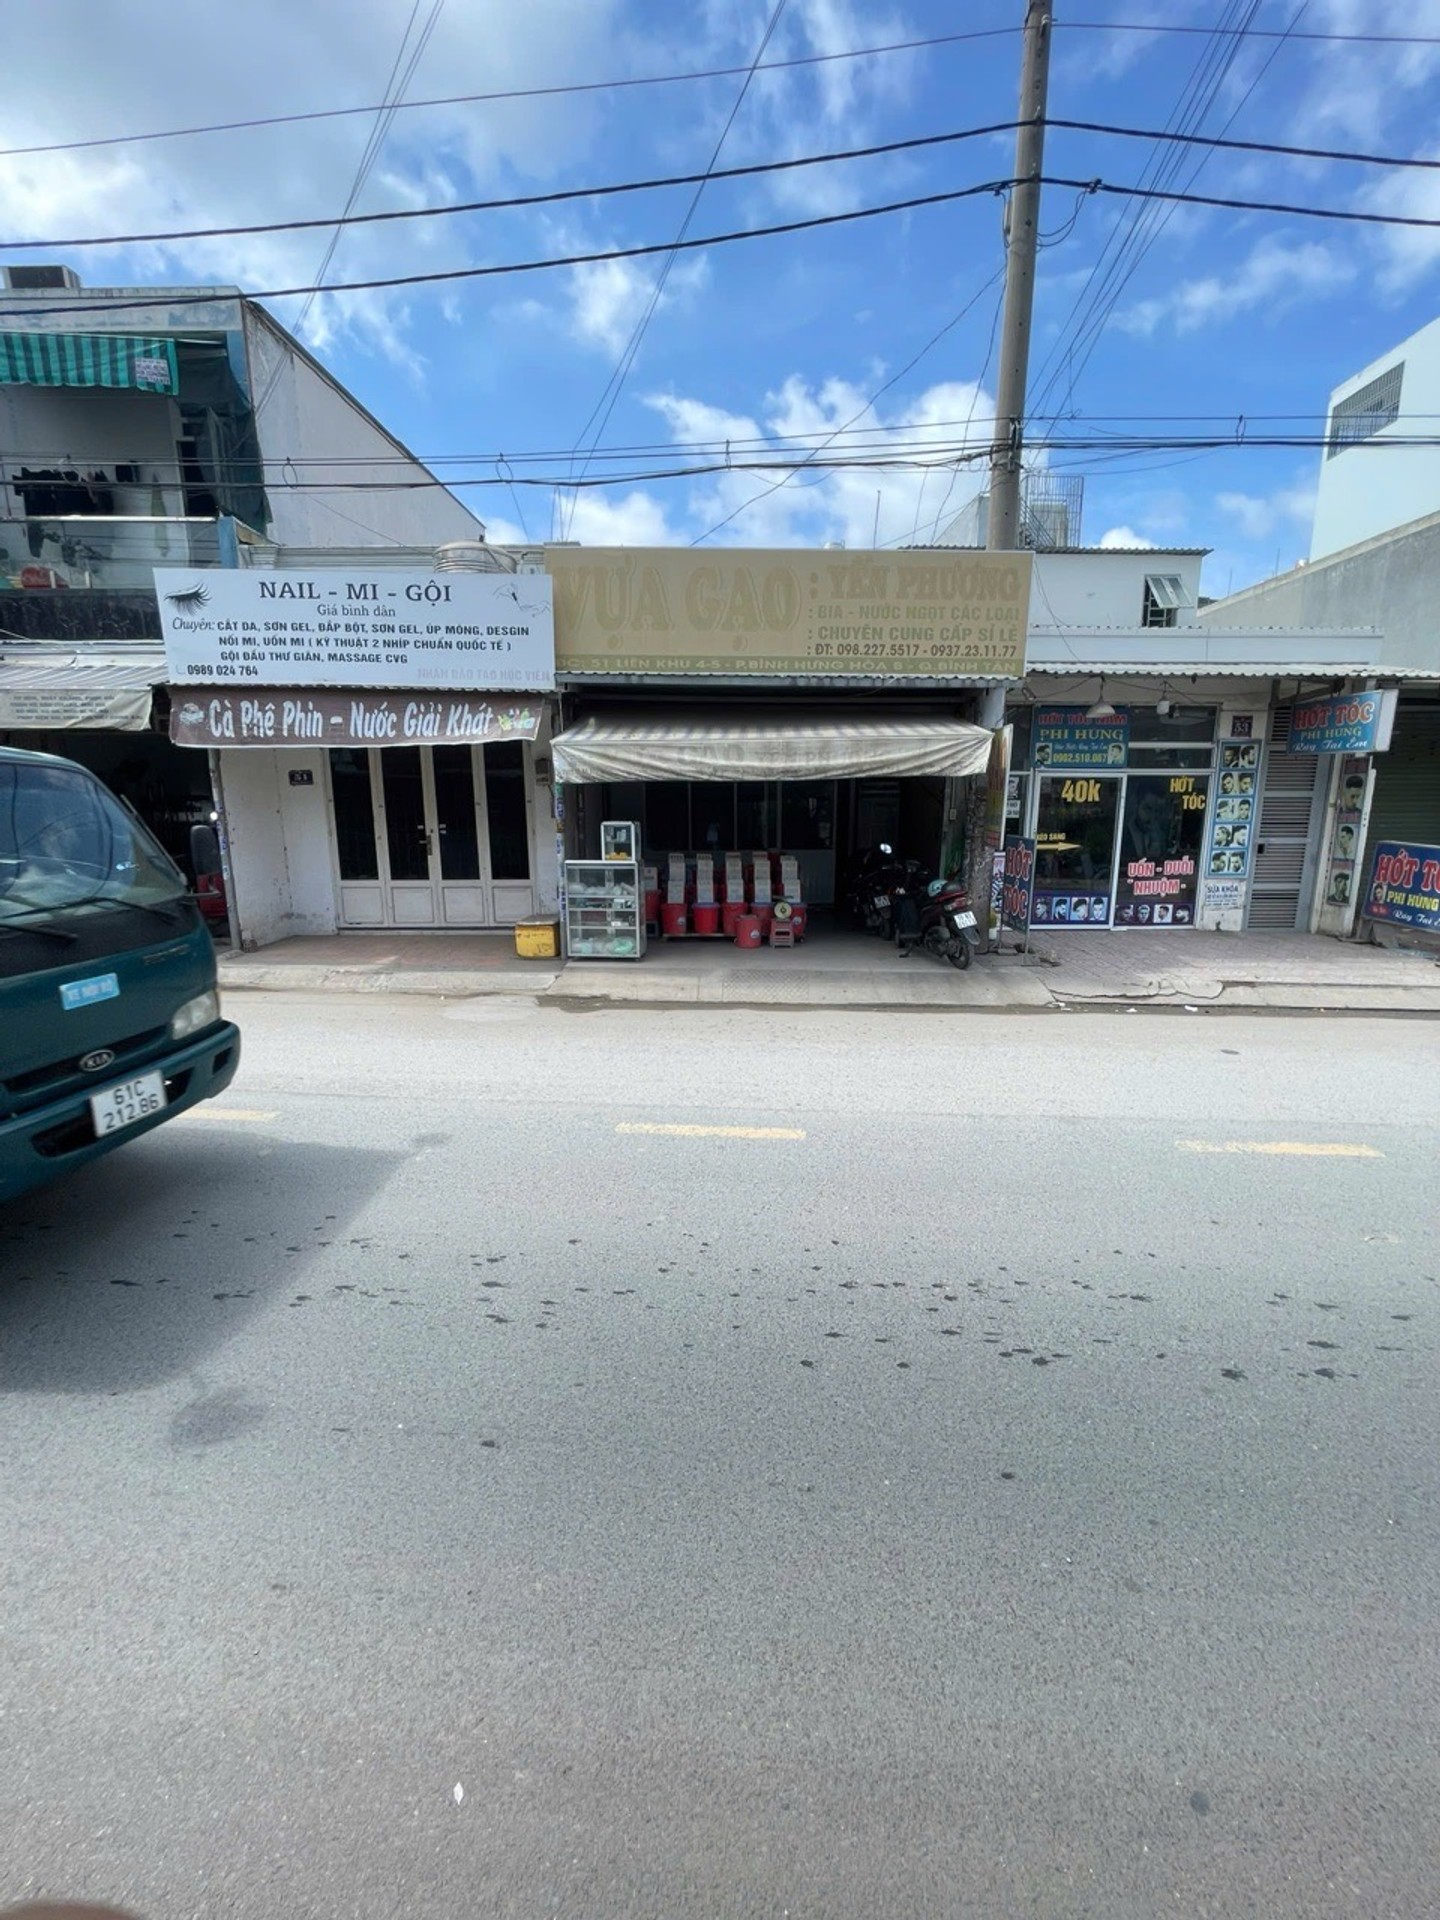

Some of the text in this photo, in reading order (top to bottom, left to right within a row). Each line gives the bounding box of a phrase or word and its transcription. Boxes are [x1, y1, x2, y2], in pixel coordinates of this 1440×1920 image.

[259, 582, 320, 600] NAIL
[346, 583, 379, 600] MI
[405, 579, 452, 606] GỘI
[317, 604, 396, 617] Giá bình dân
[817, 607, 843, 619] BIA
[950, 604, 981, 619] CÁC
[172, 617, 214, 633] Chuyên:
[217, 620, 238, 631] CẮT
[264, 620, 287, 632] SƠN
[372, 624, 395, 634] SƠN
[487, 626, 530, 636] DESGIN
[817, 624, 883, 640] CHUYÊN
[889, 627, 934, 641] CUNG
[939, 622, 973, 641] CẤP
[218, 635, 239, 646] NỐI
[263, 635, 288, 646] UỐN
[291, 637, 305, 646] MI
[333, 637, 369, 649] THUẬT
[372, 640, 379, 648] 2
[456, 638, 487, 651] QUỐC
[490, 639, 504, 651] TẾ
[814, 644, 834, 656] ĐT:
[836, 643, 920, 657] 098.227.5517
[930, 644, 1017, 658] 0937.23.11.77
[220, 651, 240, 661] GỘI
[268, 652, 291, 661] THƯ
[327, 653, 382, 663] MASSAGE
[386, 655, 408, 664] CVG
[591, 659, 609, 668] 51
[656, 659, 691, 669] KHU
[187, 664, 258, 676] 0989 024 764
[208, 699, 235, 738] Cà
[240, 699, 275, 738] Phê
[282, 699, 323, 738] Phin
[349, 701, 397, 739] Nước
[403, 701, 443, 737] Giải
[445, 702, 494, 737] Khát
[1334, 697, 1375, 726] TÓC
[1040, 729, 1069, 741] PHI
[1301, 730, 1320, 742] PHI
[1169, 775, 1195, 793] HỚT
[1182, 794, 1206, 810] TÓC
[1005, 840, 1033, 882] HỚT
[1128, 857, 1155, 877] UỐN
[1374, 848, 1420, 888] HỚT
[1133, 876, 1180, 898] NHUỘM
[1003, 879, 1029, 920] TÓC
[1386, 890, 1406, 906] PHI
[86, 1053, 110, 1068] KIA
[113, 1080, 145, 1105] 61C
